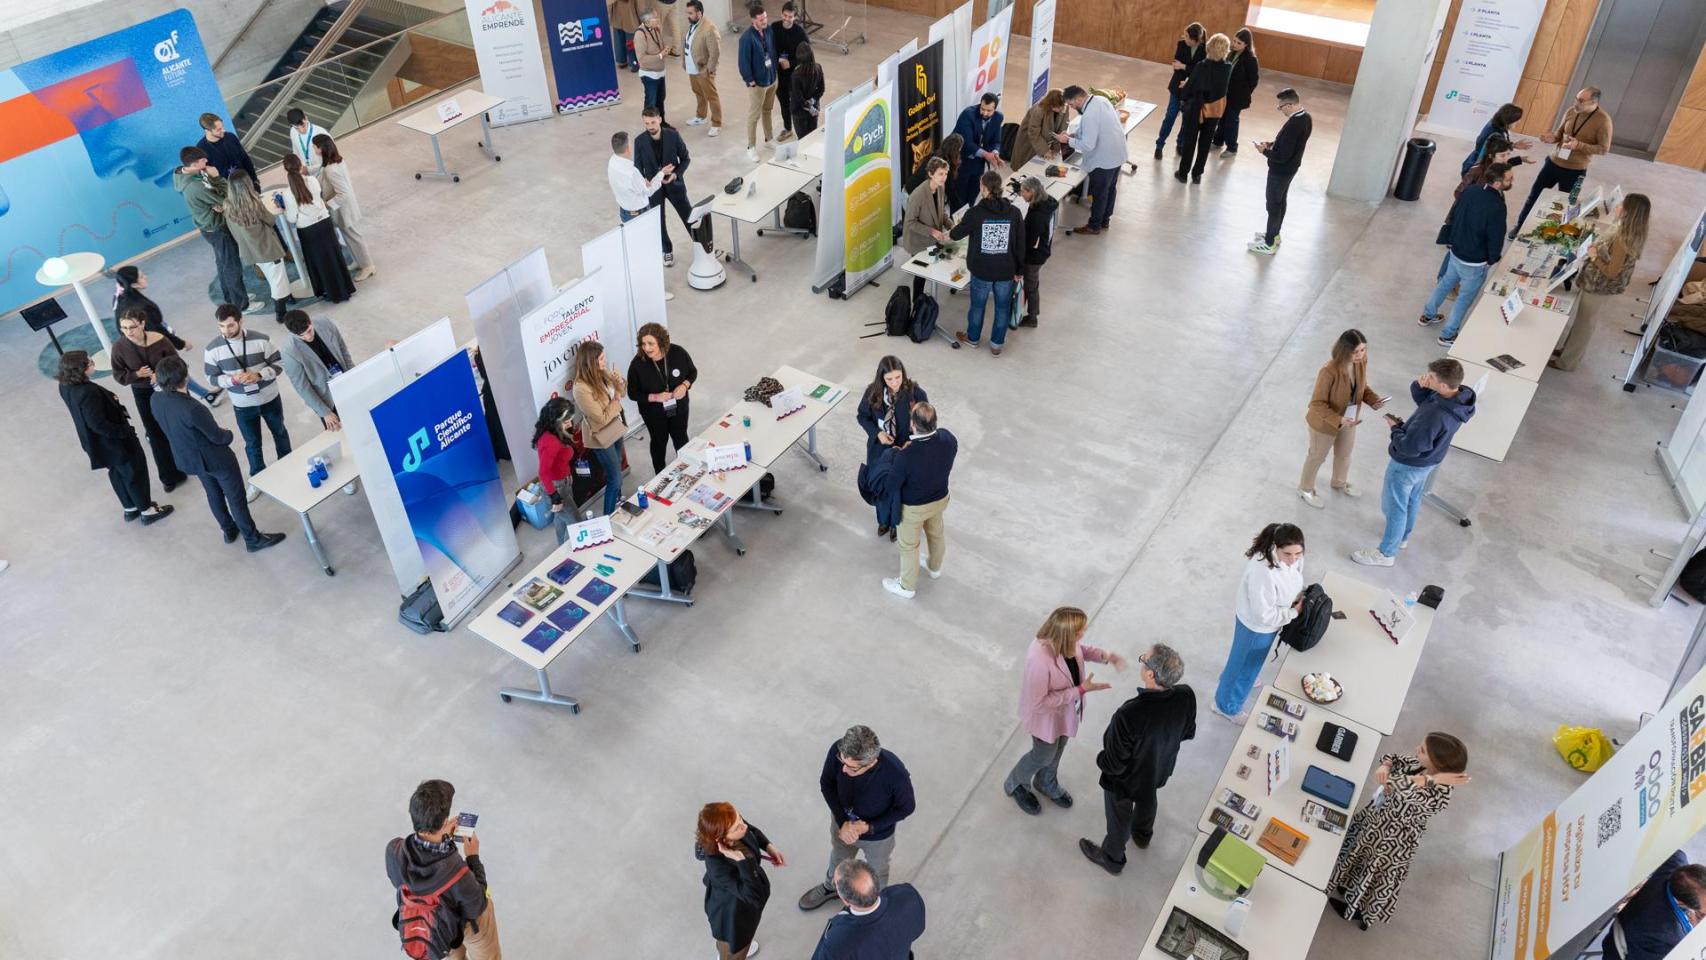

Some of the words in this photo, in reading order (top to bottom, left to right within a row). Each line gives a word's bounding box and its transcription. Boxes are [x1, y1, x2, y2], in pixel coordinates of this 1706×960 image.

[481, 9, 524, 24] ALICANTE
[482, 18, 525, 31] EMPRENDE
[162, 58, 192, 75] ALICANTE
[863, 124, 884, 146] Fych
[562, 295, 595, 320] TALENTO
[539, 306, 591, 344] EMPRESARIAL
[549, 325, 573, 345] JOVEN
[434, 410, 462, 434] Parque
[437, 412, 473, 442] Científico
[440, 423, 471, 450] Alicante
[1648, 749, 1664, 818] odoo
